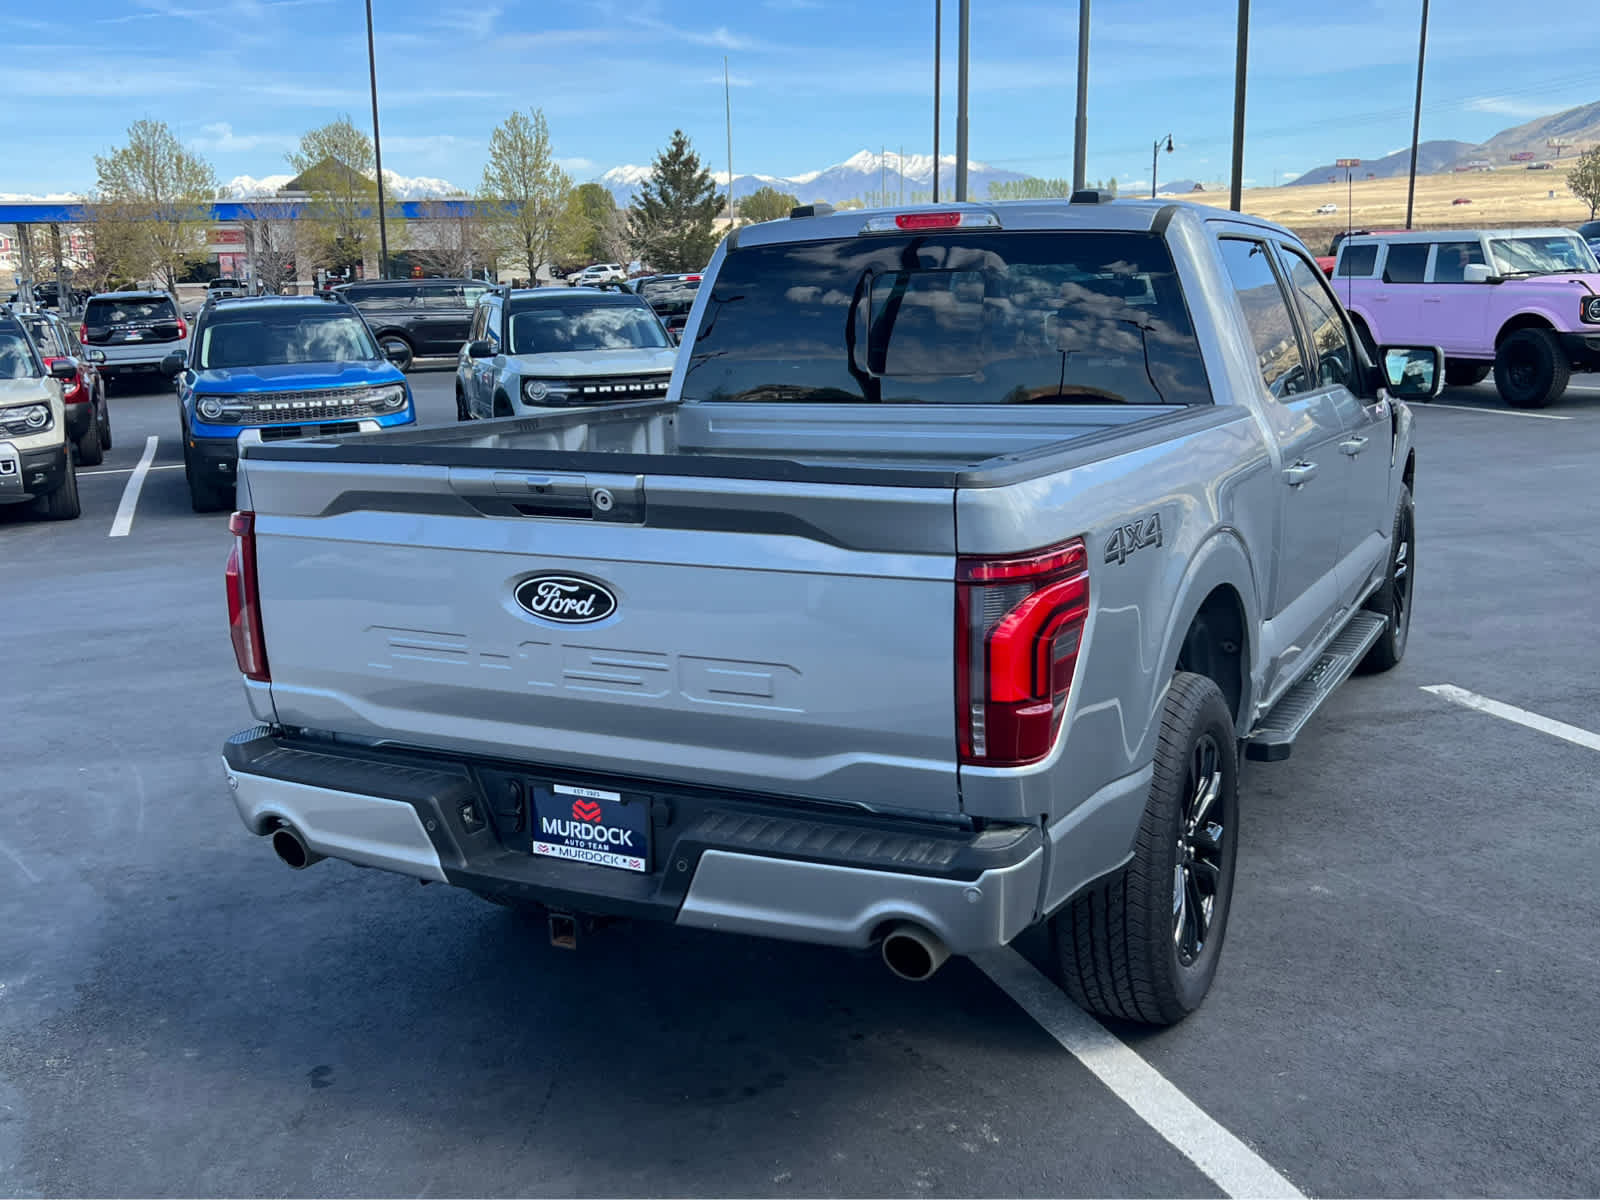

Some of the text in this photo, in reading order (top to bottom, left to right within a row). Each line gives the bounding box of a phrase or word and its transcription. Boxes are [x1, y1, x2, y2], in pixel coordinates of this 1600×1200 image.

[583, 382, 670, 393] BRONCO
[531, 581, 596, 616] Ford
[363, 624, 807, 713] F-150
[542, 816, 633, 847] MURDOCK
[559, 845, 619, 865] MURDOCK
[564, 838, 610, 851] AUTO TEAM
